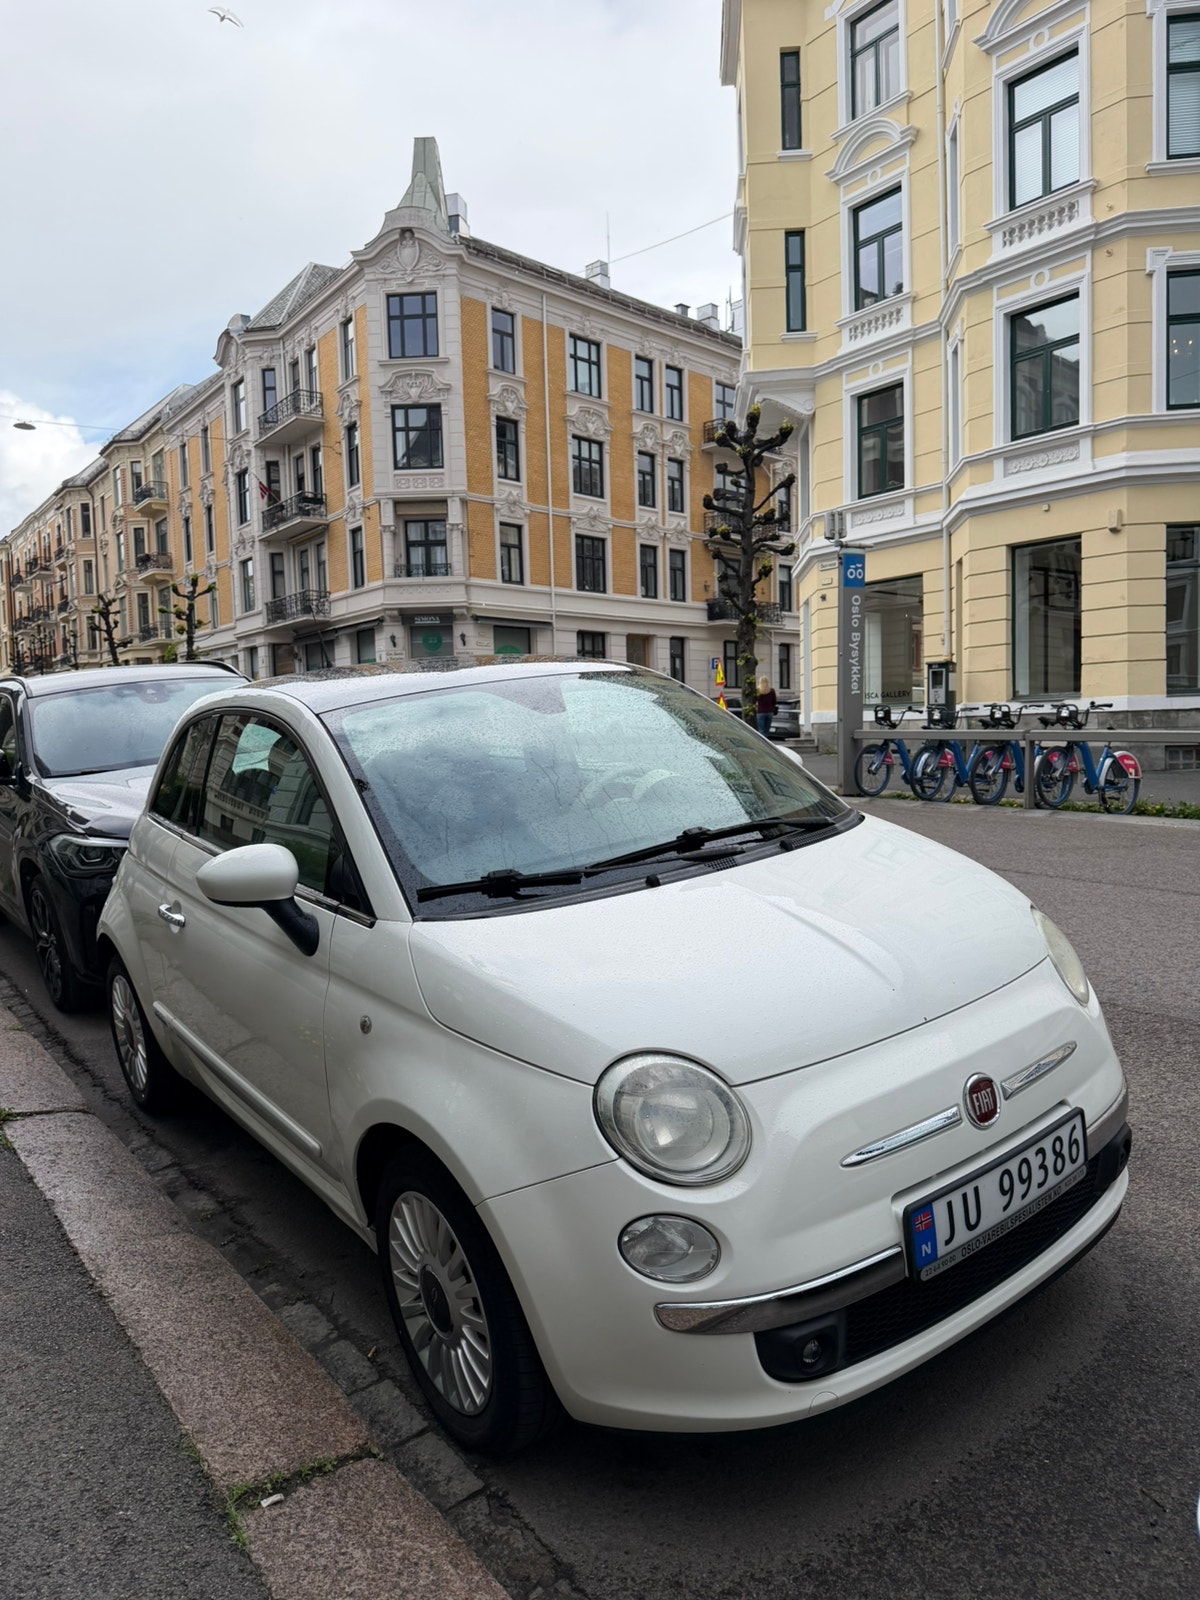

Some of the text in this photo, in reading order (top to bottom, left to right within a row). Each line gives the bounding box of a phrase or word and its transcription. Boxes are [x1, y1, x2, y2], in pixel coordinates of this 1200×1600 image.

[849, 595, 861, 694] Oslo Bysykkel
[864, 690, 911, 699] ISCA GALLERY
[972, 1088, 994, 1116] FIAT
[944, 1123, 1080, 1247] JU 99386
[921, 1241, 932, 1257] N
